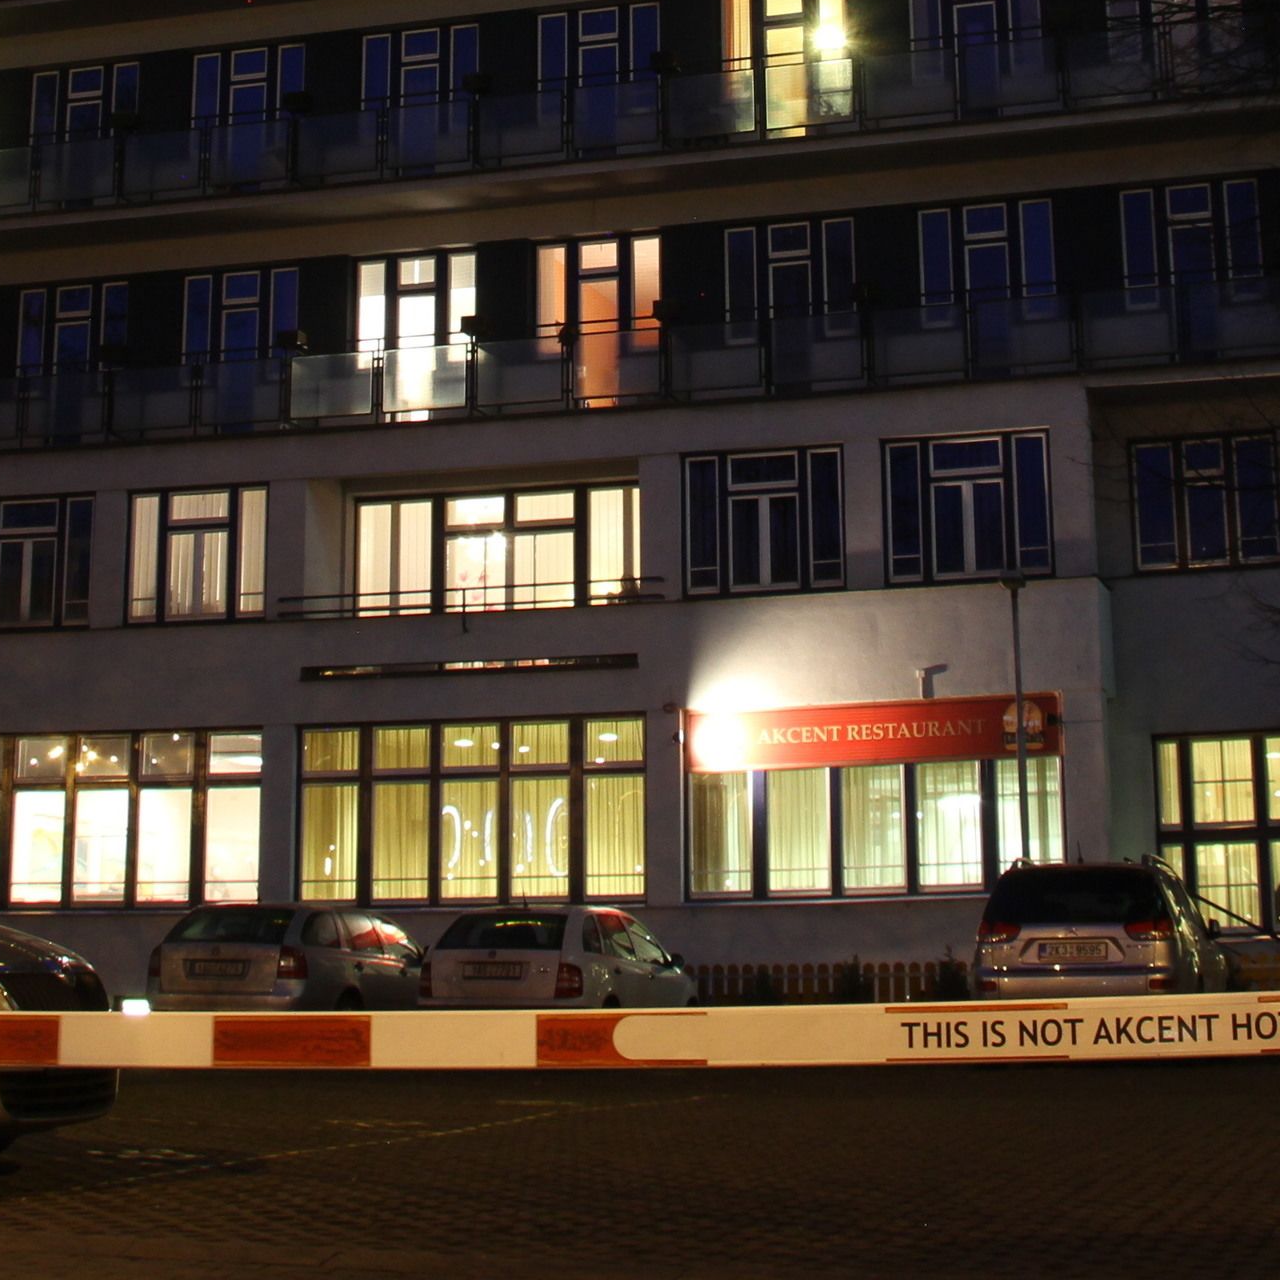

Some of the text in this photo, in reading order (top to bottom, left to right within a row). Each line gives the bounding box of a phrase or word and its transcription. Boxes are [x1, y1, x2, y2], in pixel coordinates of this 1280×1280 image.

[758, 725, 841, 745] AKCENT
[846, 719, 985, 741] RESTAURANT
[901, 1021, 970, 1048] THIS
[982, 1021, 1007, 1047] IS
[1019, 1019, 1083, 1046] NOT
[1093, 1014, 1219, 1045] AKCENT
